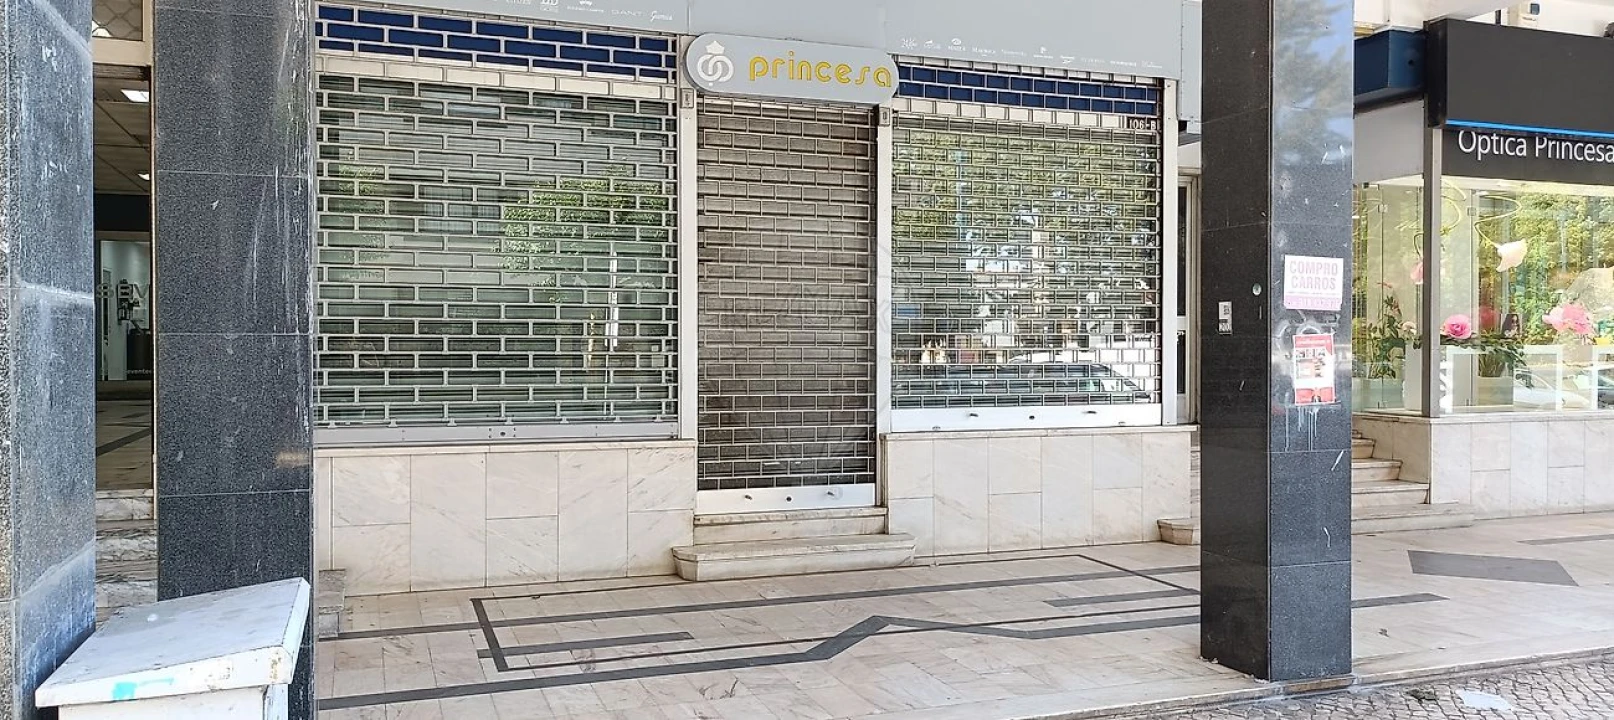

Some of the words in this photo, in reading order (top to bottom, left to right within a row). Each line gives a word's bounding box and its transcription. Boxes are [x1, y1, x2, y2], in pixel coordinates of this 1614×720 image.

[749, 51, 892, 88] princesa
[1535, 136, 1614, 164] Princesa
[1290, 260, 1338, 276] COMPRO
[1291, 275, 1337, 290] CARROS
